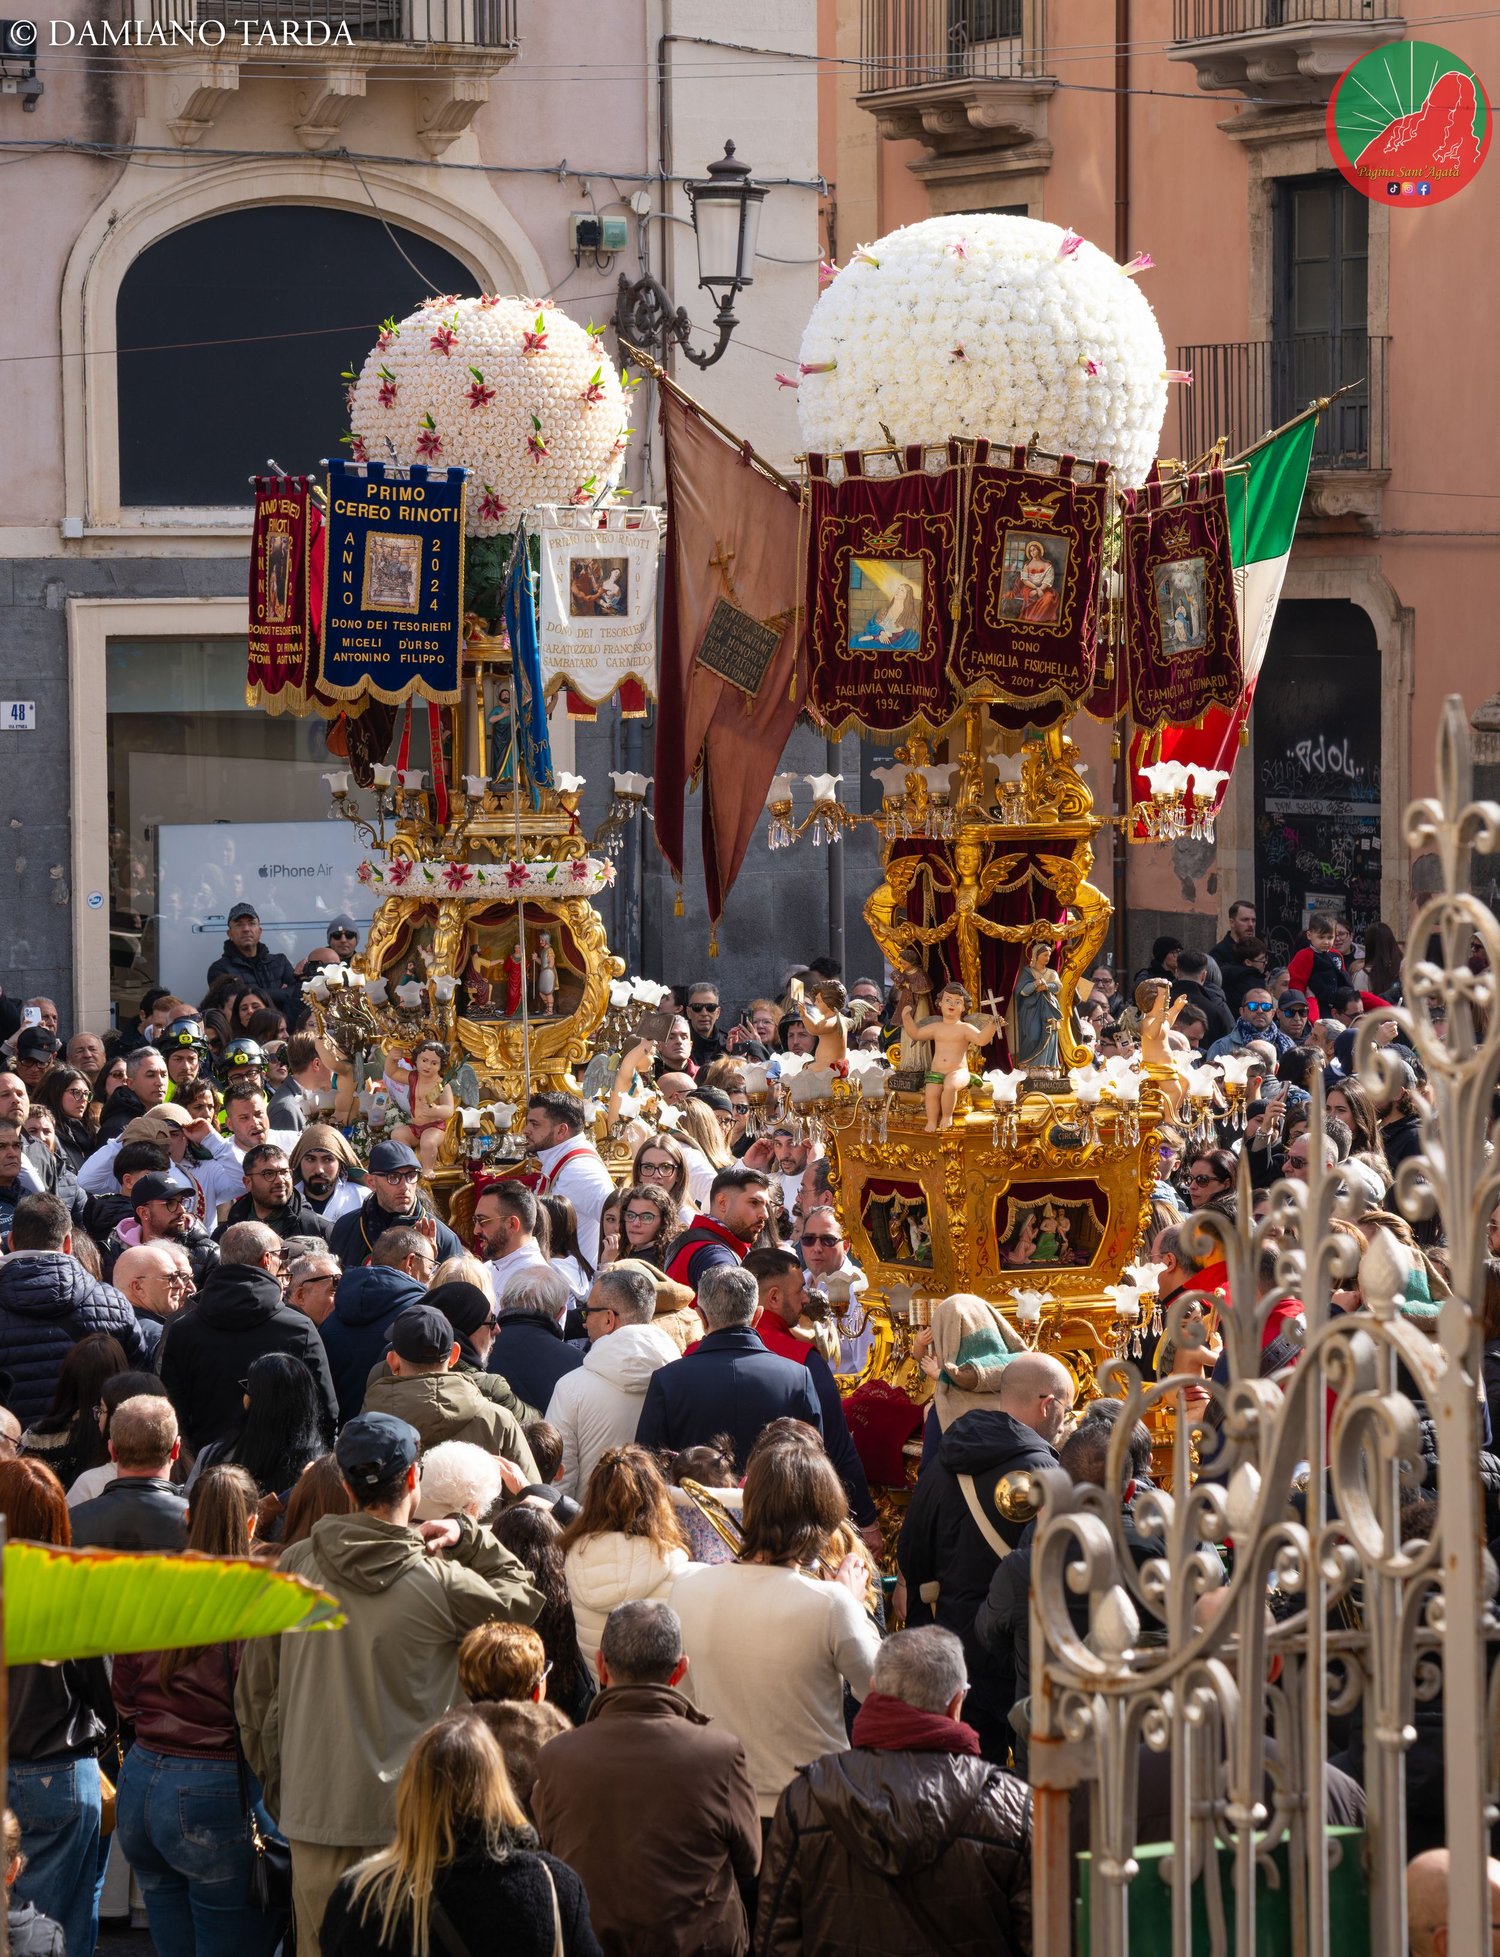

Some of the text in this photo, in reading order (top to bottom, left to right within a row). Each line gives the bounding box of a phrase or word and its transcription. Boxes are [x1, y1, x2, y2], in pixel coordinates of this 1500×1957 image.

[367, 484, 425, 501] PRIMO
[335, 499, 459, 522] CEREO RINOTI
[549, 533, 650, 550] PRIMO CEREO RINOTI
[331, 618, 451, 632] DONO DEI TESORIERI
[546, 621, 573, 637] DONO
[576, 628, 593, 638] DEI
[342, 637, 439, 650] MICELI D'URSO
[1011, 640, 1040, 653] DONO
[333, 652, 445, 664] ANTONINO FILIPPO
[543, 655, 651, 668] SAMBATARO CARMELO
[971, 651, 1079, 678] FAMIGLIA FISICHELLA
[873, 668, 902, 679] DONO
[1011, 675, 1034, 687] 2001
[835, 683, 938, 698] TAGLIAVIA VALENTINO
[1147, 674, 1228, 701] FAMIGLIA LEONARDI
[875, 698, 900, 710] 1994
[11, 704, 25, 720] 48
[269, 863, 334, 878] iPhone Air
